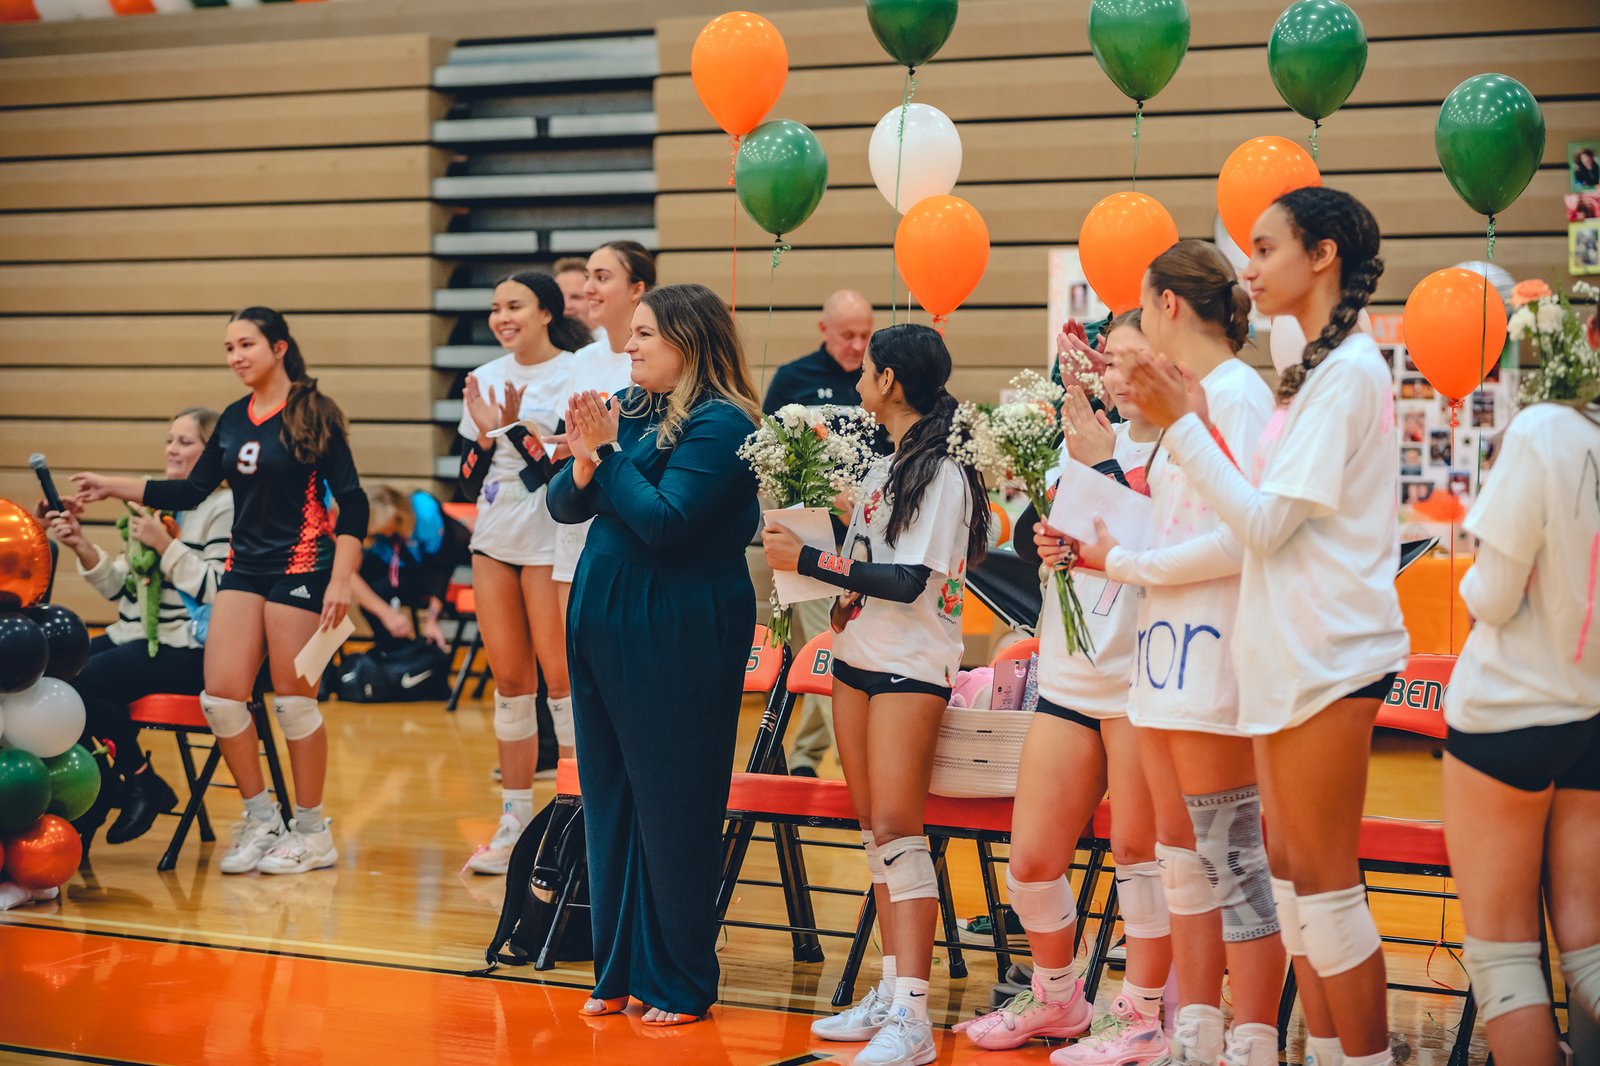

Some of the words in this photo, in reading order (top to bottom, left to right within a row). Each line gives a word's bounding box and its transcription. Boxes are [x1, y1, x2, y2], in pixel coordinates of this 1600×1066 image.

[236, 440, 261, 475] 9
[818, 551, 853, 576] EAST
[811, 649, 834, 676] B
[1384, 677, 1448, 711] BEN
